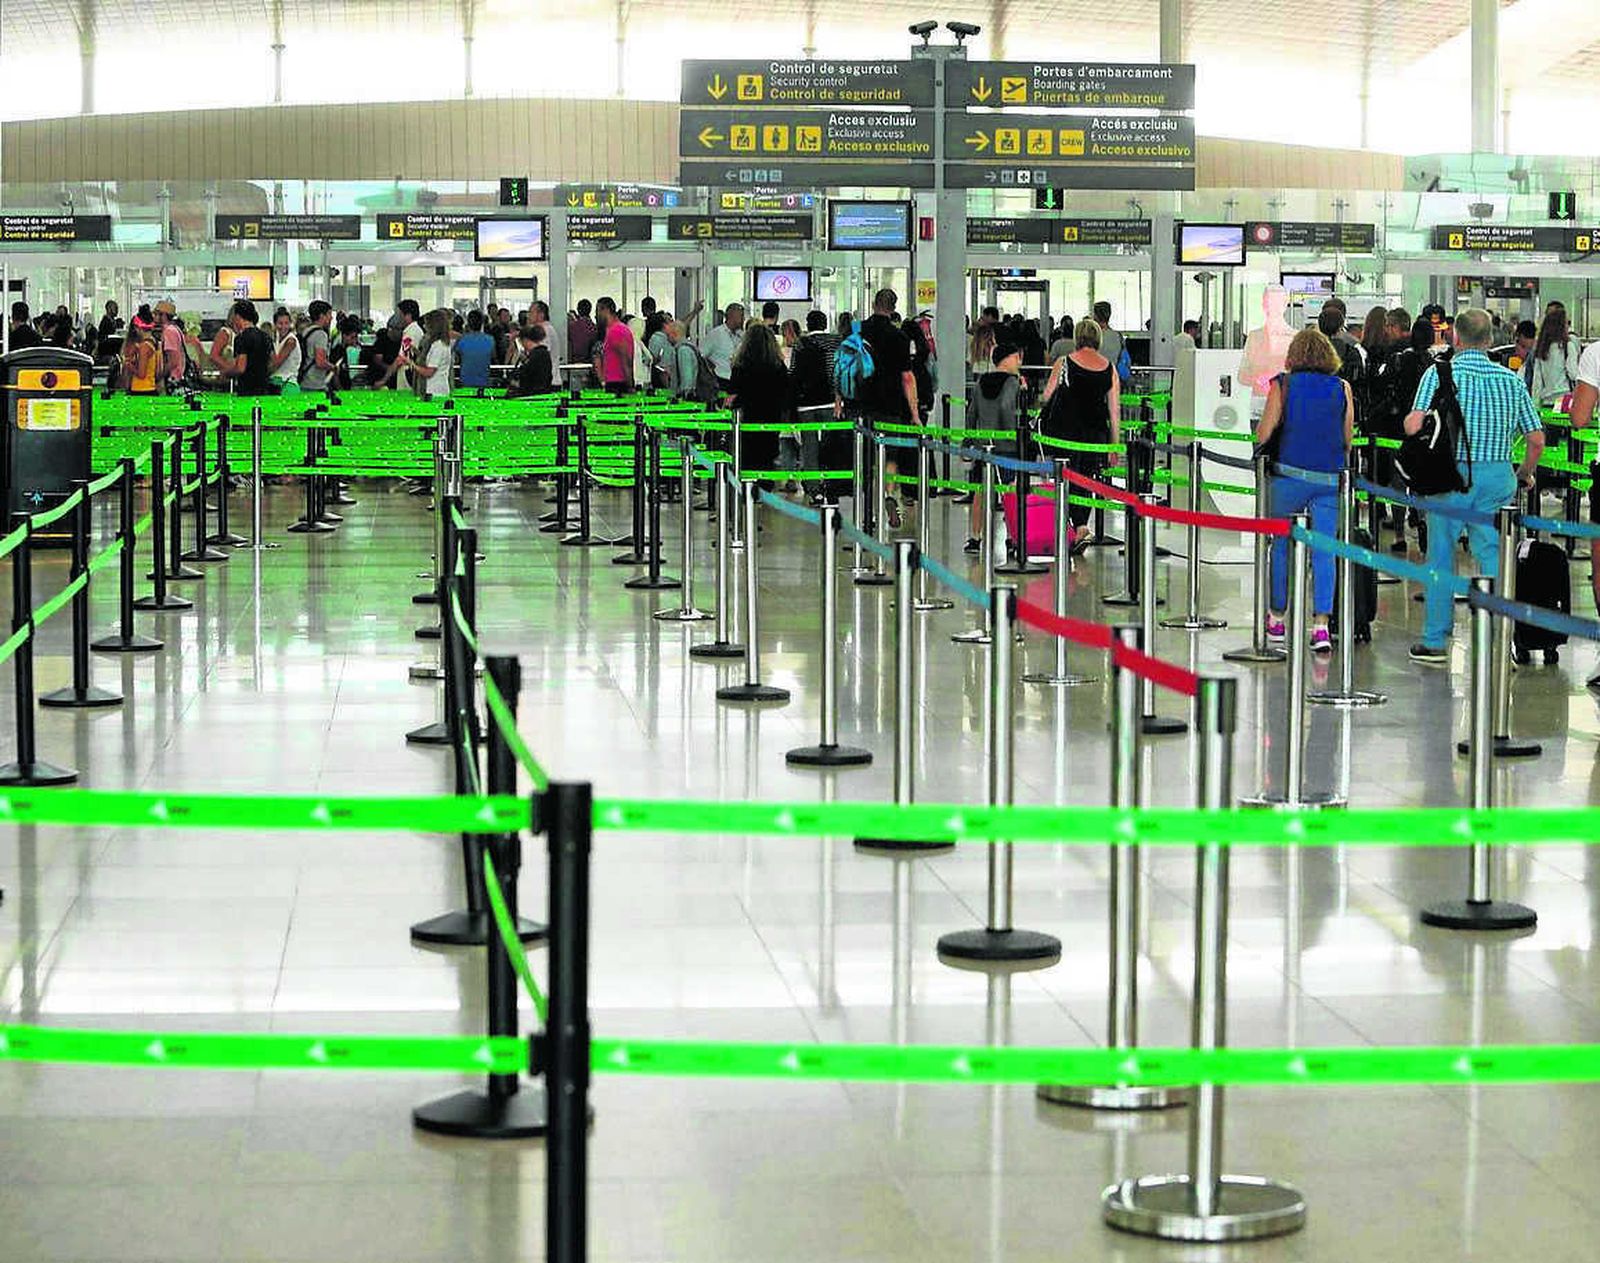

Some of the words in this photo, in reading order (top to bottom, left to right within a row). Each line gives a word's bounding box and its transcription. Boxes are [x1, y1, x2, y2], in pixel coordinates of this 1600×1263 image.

[770, 62, 815, 74] Control
[820, 62, 835, 74] de
[838, 63, 899, 76] seguretat
[1033, 66, 1073, 77] Portes
[1078, 66, 1173, 79] d'embarcament
[770, 76, 809, 88] Security
[813, 76, 848, 86] control
[1033, 79, 1075, 91] Boarding
[1079, 81, 1106, 91] gates
[770, 88, 815, 99] Control
[820, 89, 835, 100] de
[838, 89, 901, 101] seguridad
[1033, 92, 1080, 102] Puertas
[1085, 92, 1100, 103] de
[1104, 93, 1165, 105] embarque
[868, 114, 917, 127] exclusiu
[1092, 118, 1127, 130] Accés
[1130, 119, 1178, 131] exclusiu
[828, 127, 870, 138] Exclusive
[872, 129, 905, 139] access
[1091, 131, 1133, 141] Exclusive
[1134, 133, 1166, 142] access
[828, 141, 872, 151] Acceso
[875, 141, 930, 152] exclusivo
[1061, 137, 1084, 147] CREW
[1092, 144, 1134, 155] Acceso
[1137, 145, 1191, 157] exclusivo
[41, 231, 75, 239] seguridad
[1502, 228, 1533, 236] seguretat
[1502, 242, 1534, 250] seguridad
